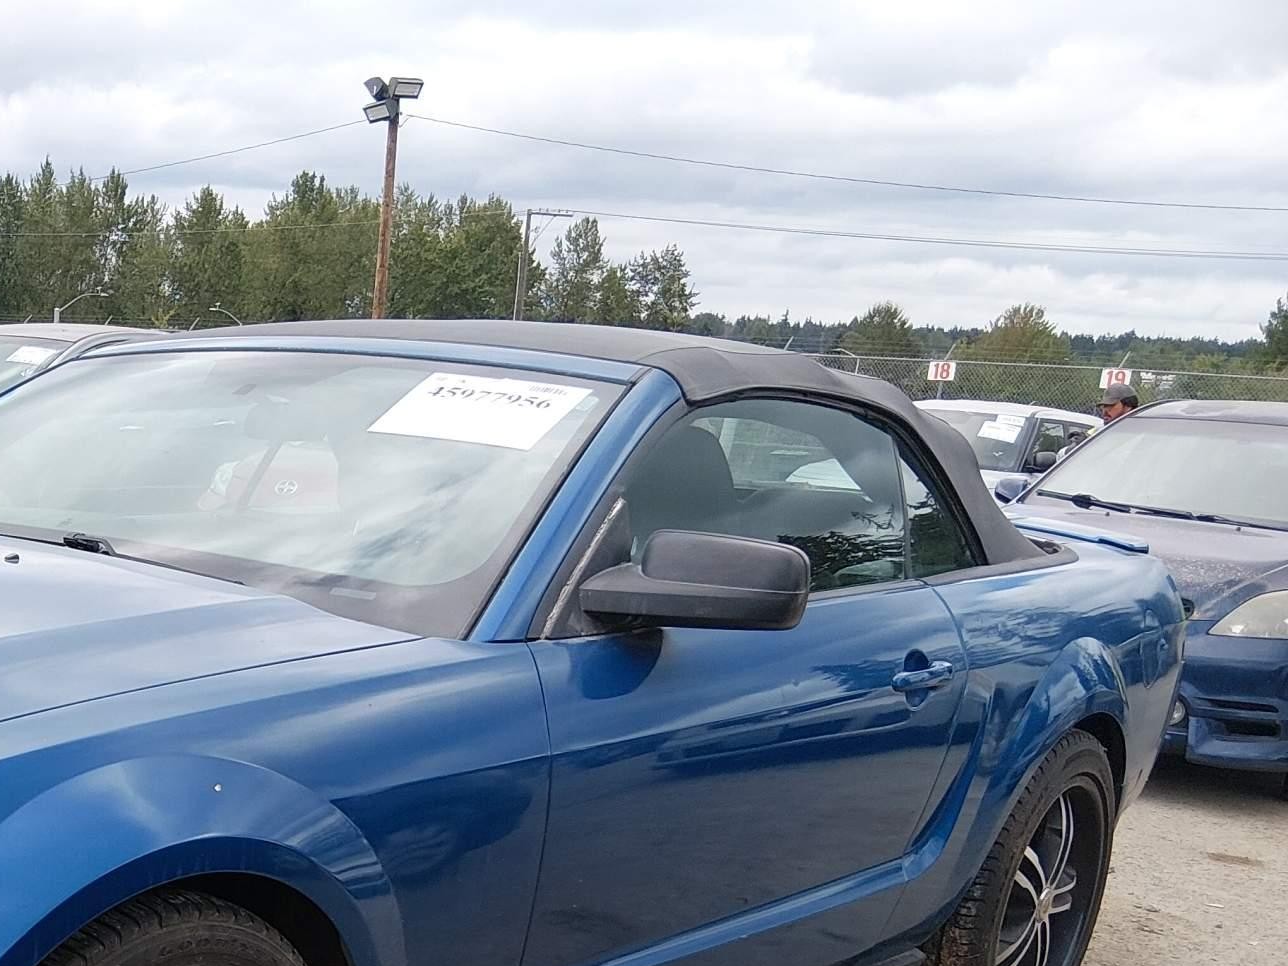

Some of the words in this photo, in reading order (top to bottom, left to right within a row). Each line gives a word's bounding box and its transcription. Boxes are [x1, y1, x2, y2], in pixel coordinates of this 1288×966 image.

[933, 362, 951, 380] 18
[1106, 369, 1126, 388] 19
[428, 385, 552, 409] 45977956
